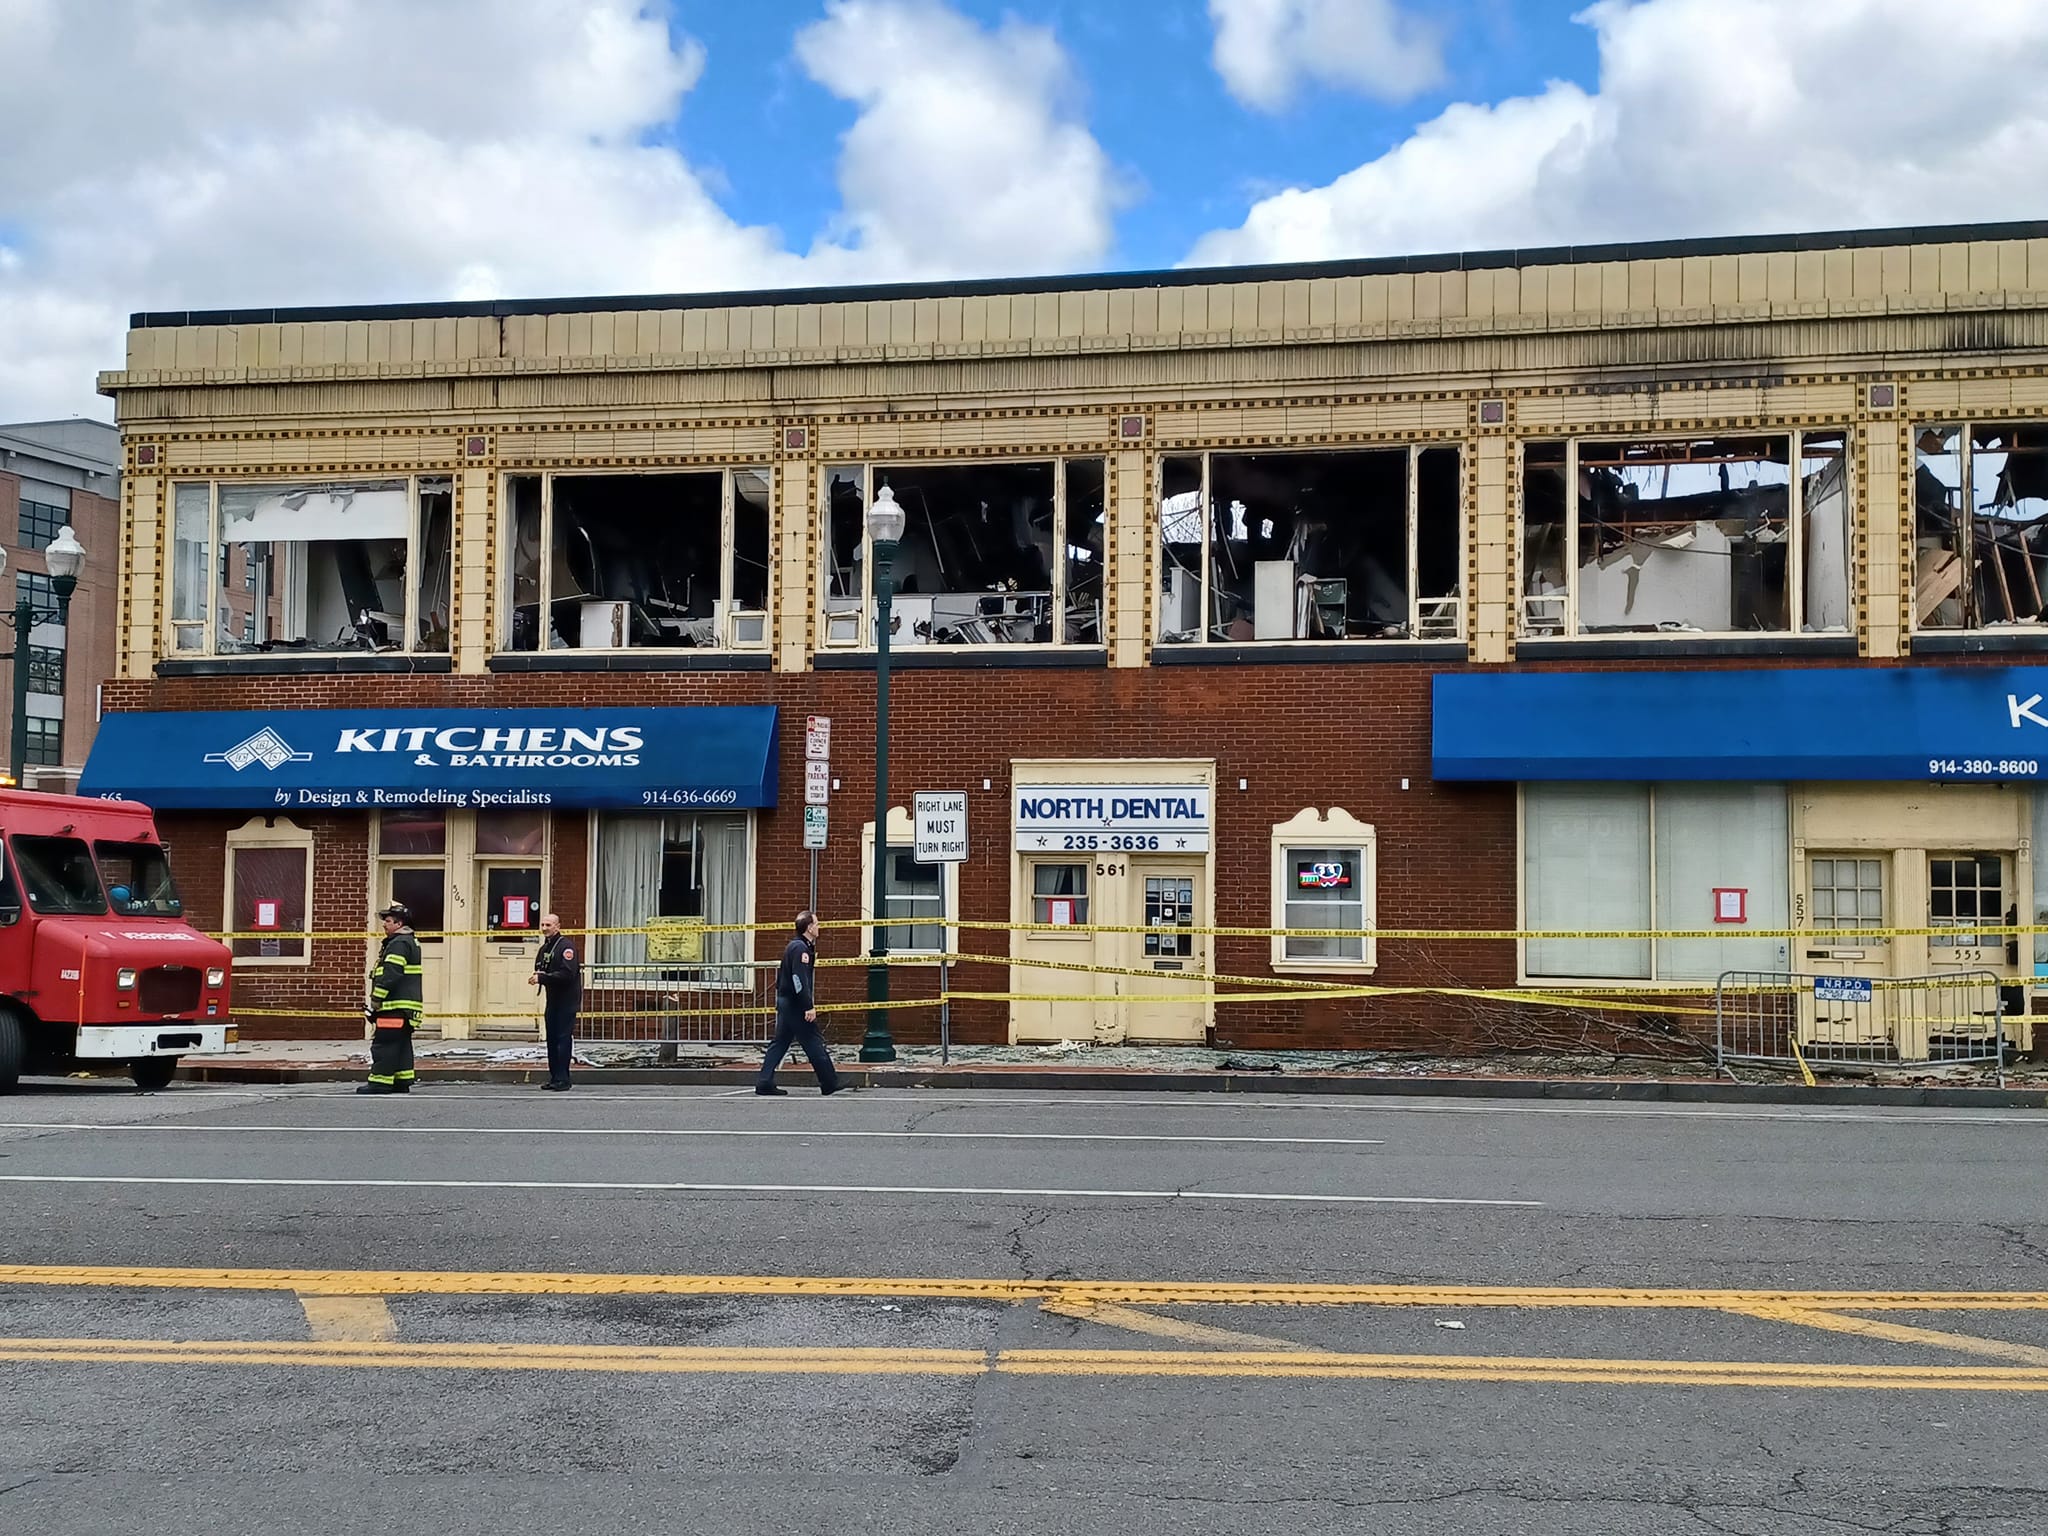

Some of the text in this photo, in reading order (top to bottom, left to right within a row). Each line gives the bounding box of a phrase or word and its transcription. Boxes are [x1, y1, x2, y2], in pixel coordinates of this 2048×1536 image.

[334, 726, 644, 752] KITCHENS
[413, 753, 641, 768] & BATHROOMS
[1928, 759, 2038, 774] 914-380-8600
[274, 787, 552, 808] by Design & Remodeling Specialists
[642, 789, 737, 804] 914-636-6669
[917, 800, 964, 812] RIGHT LANE
[1020, 798, 1205, 819] NORTH DENTAL
[927, 820, 955, 834] MUST
[918, 841, 965, 853] TURN RIGHT
[1063, 835, 1159, 850] 235-3636
[1096, 864, 1126, 876] 561
[1796, 893, 1804, 927] 557
[1954, 950, 1981, 961] 555
[1823, 979, 1865, 990] N.R.P.D.
